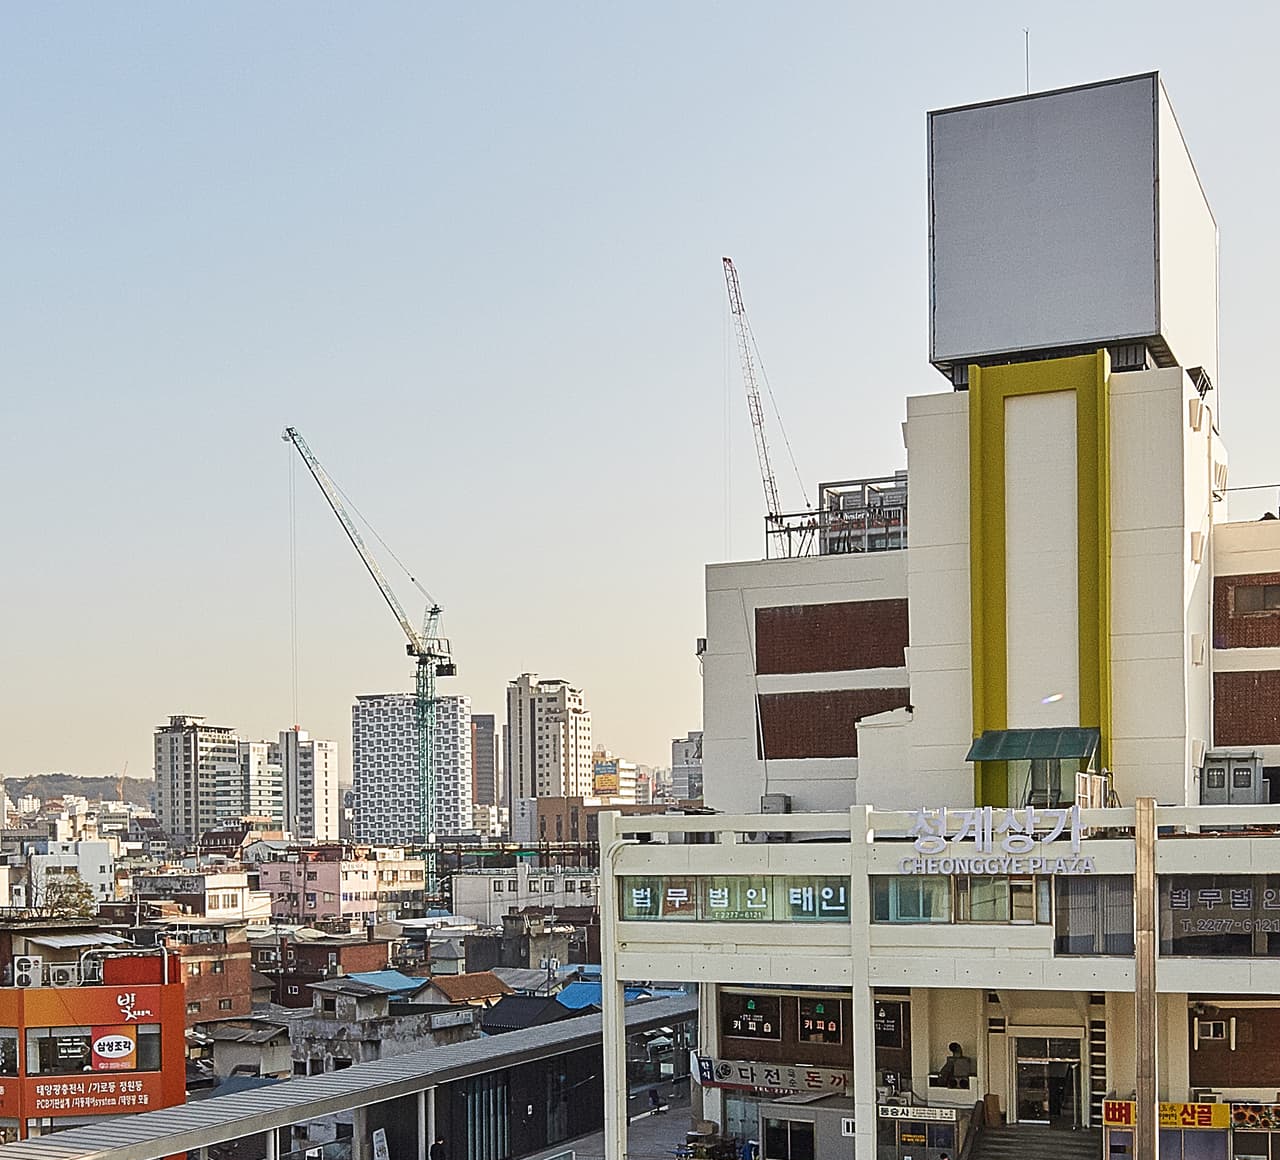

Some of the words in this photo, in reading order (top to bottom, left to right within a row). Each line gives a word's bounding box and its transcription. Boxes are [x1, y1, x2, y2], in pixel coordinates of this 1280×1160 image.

[907, 805, 1088, 854] 청계상가
[899, 857, 1028, 874] CHEONGGYE
[1028, 856, 1097, 874] PLAZA
[632, 887, 767, 909] 법무법인
[789, 886, 846, 912] 태인
[97, 1040, 132, 1053] 삼성조각
[1105, 1102, 1137, 1124] 뼈
